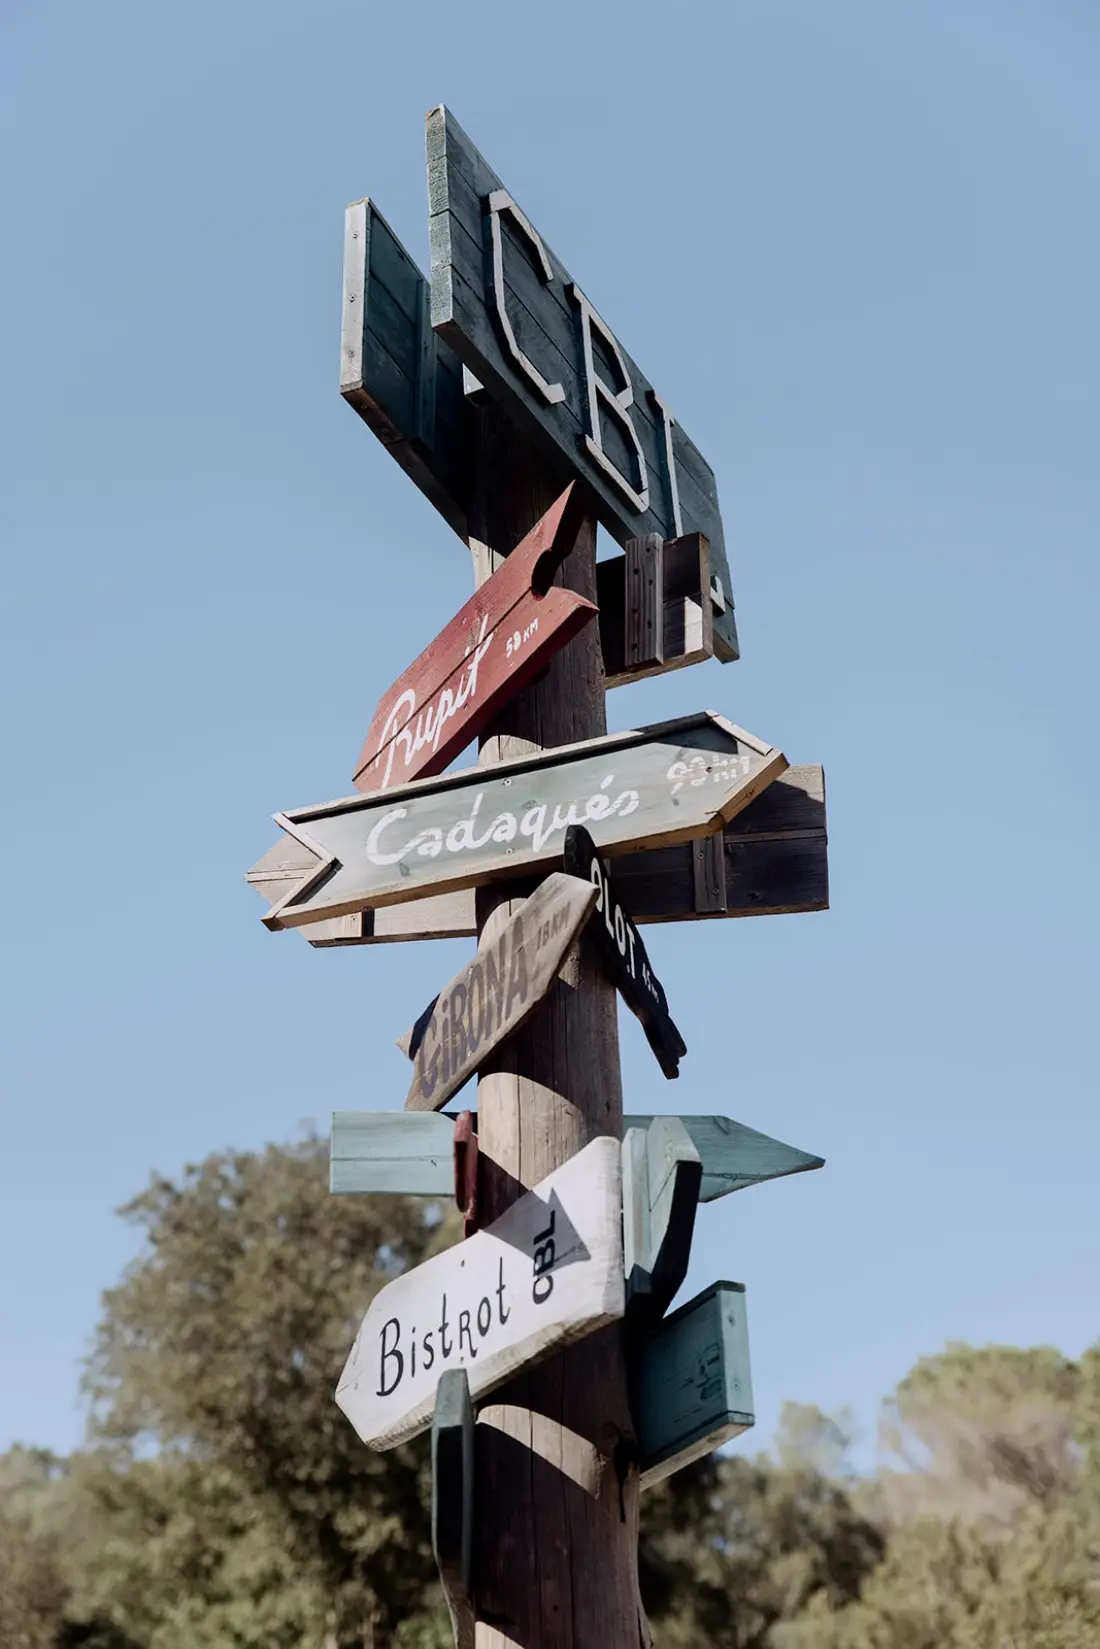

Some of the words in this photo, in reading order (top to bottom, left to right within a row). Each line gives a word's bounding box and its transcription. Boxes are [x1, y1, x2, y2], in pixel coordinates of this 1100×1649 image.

[375, 613, 494, 789] Rupit
[366, 775, 640, 865] Cadaqués
[591, 857, 636, 979] OLOT
[532, 1210, 556, 1304] CBL
